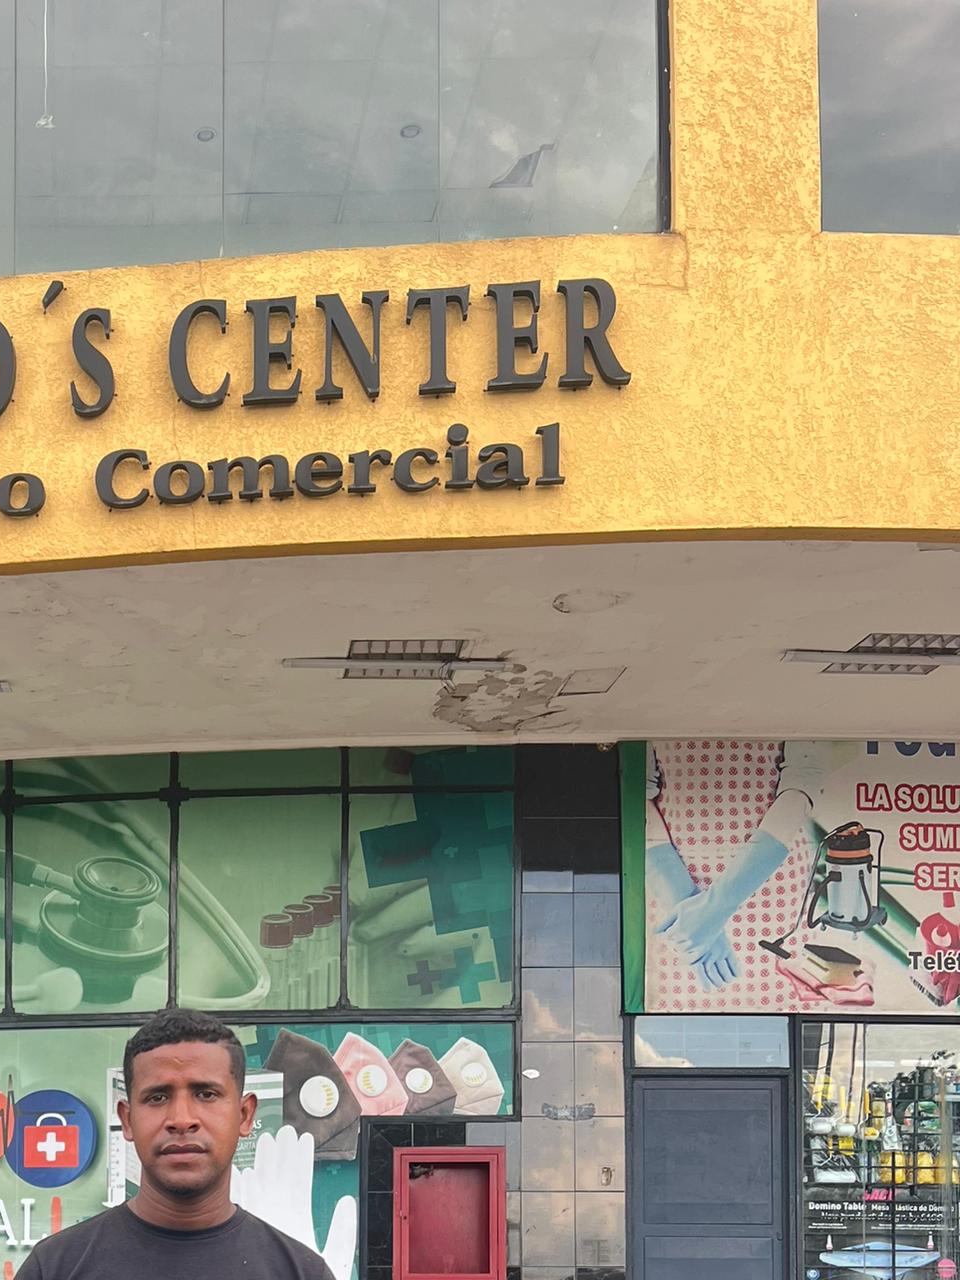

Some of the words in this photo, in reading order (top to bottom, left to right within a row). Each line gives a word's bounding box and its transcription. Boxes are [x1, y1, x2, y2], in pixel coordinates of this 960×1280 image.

[168, 278, 632, 410] CENTER
[95, 422, 566, 510] Comercial
[857, 783, 892, 811] LA
[914, 862, 960, 890] SER
[808, 1202, 842, 1210] Domino
